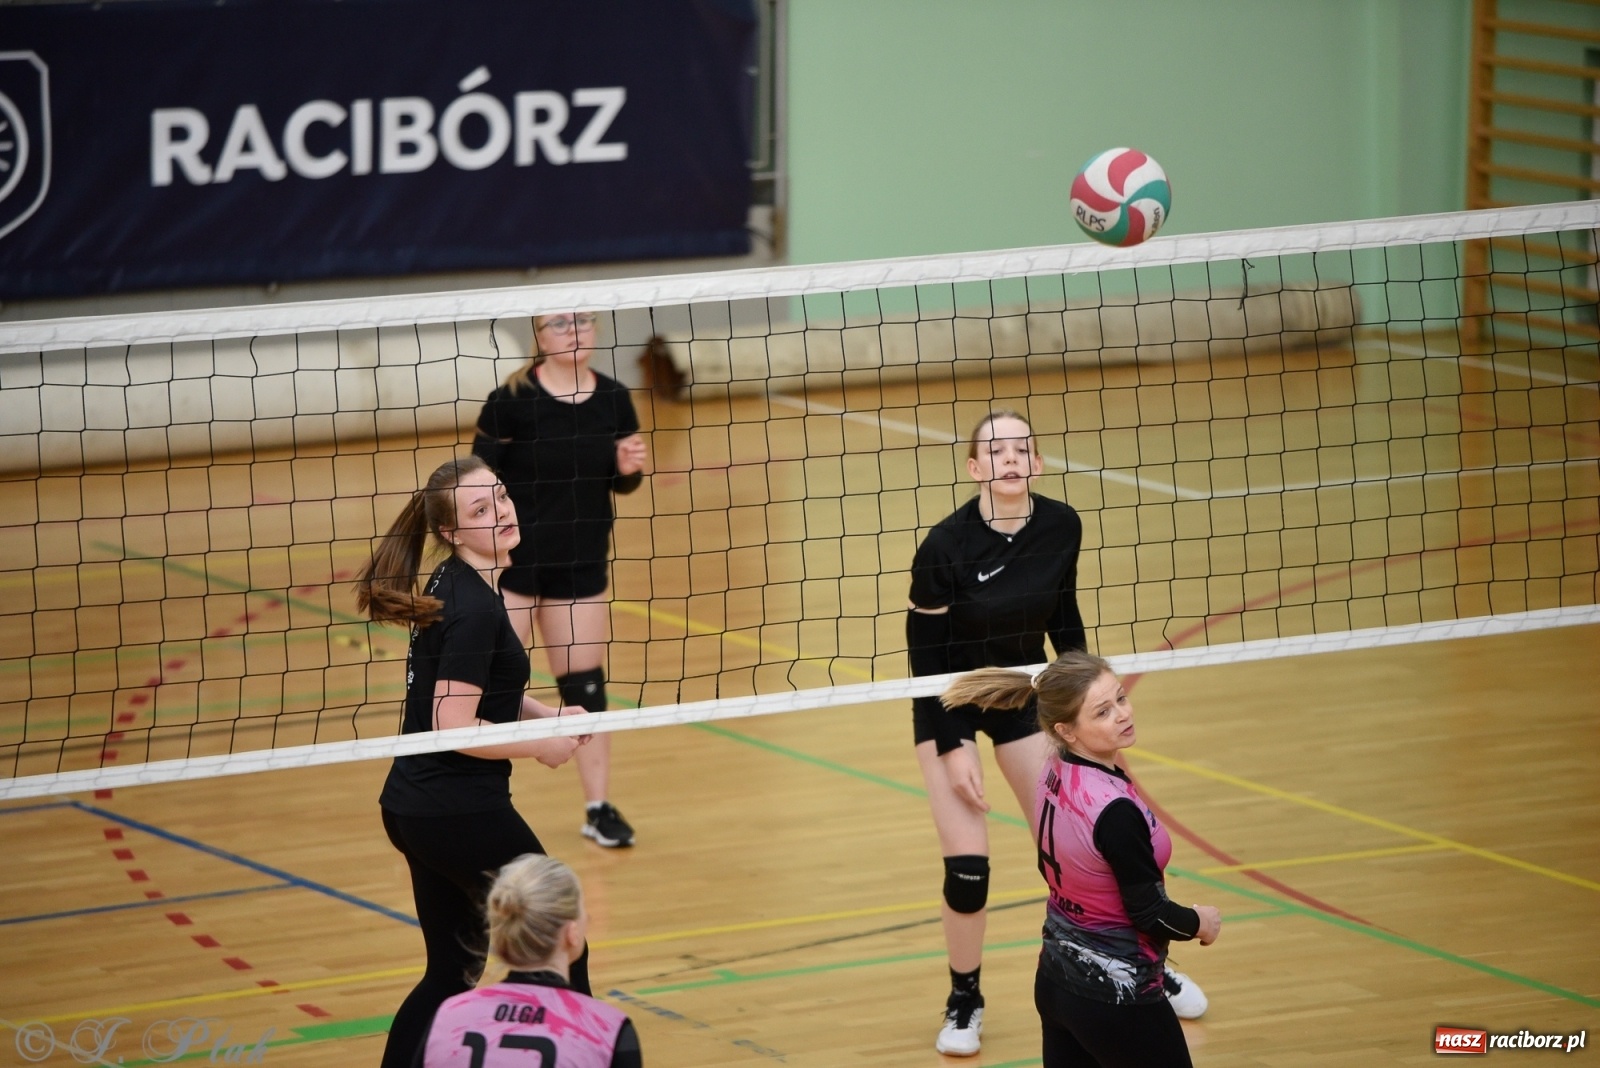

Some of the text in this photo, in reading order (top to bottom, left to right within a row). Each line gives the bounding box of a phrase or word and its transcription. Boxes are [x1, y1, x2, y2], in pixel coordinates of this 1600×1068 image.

[151, 66, 627, 186] RACIBÓRZ
[1075, 205, 1106, 232] RLPS
[1037, 797, 1063, 889] 4
[494, 1004, 546, 1024] OLGA
